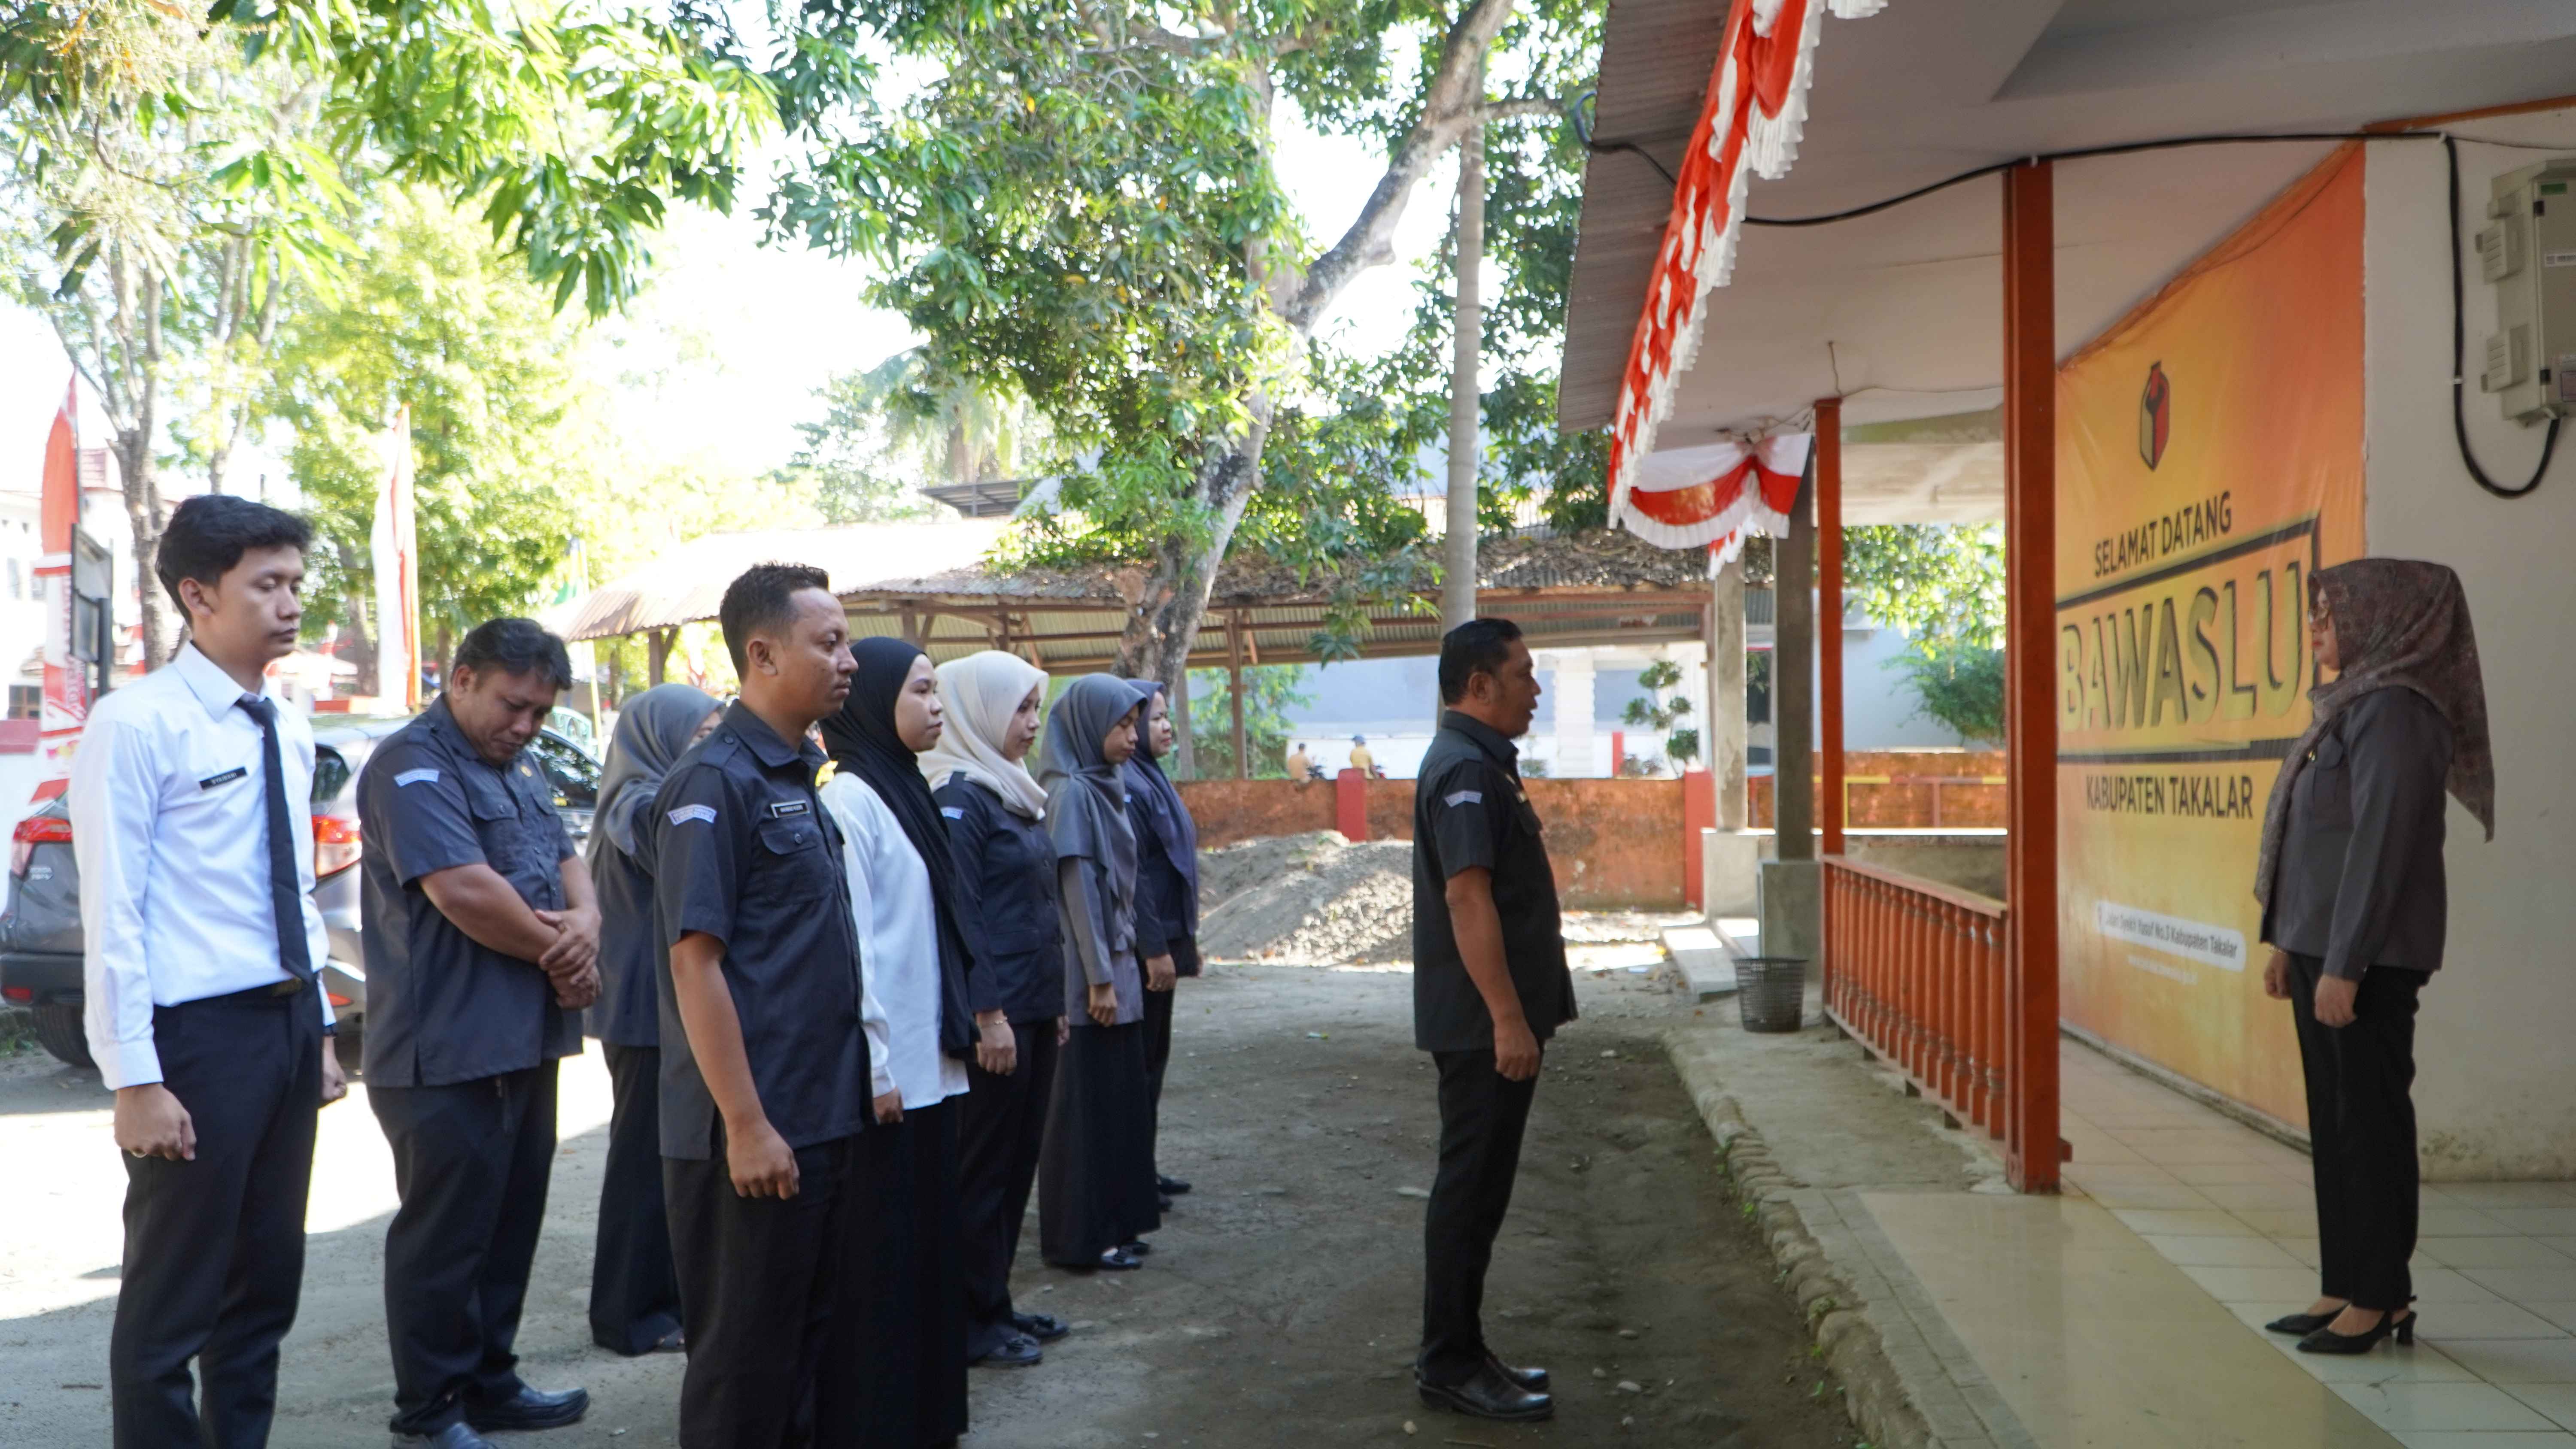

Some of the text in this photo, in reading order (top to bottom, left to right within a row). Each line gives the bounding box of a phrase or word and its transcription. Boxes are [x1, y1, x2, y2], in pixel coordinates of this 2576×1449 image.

[2095, 489, 2232, 578] SELAMAT DATANG
[2061, 560, 2303, 732] BAWASLU
[2086, 775, 2254, 819] KABUPATEN TAKALAR
